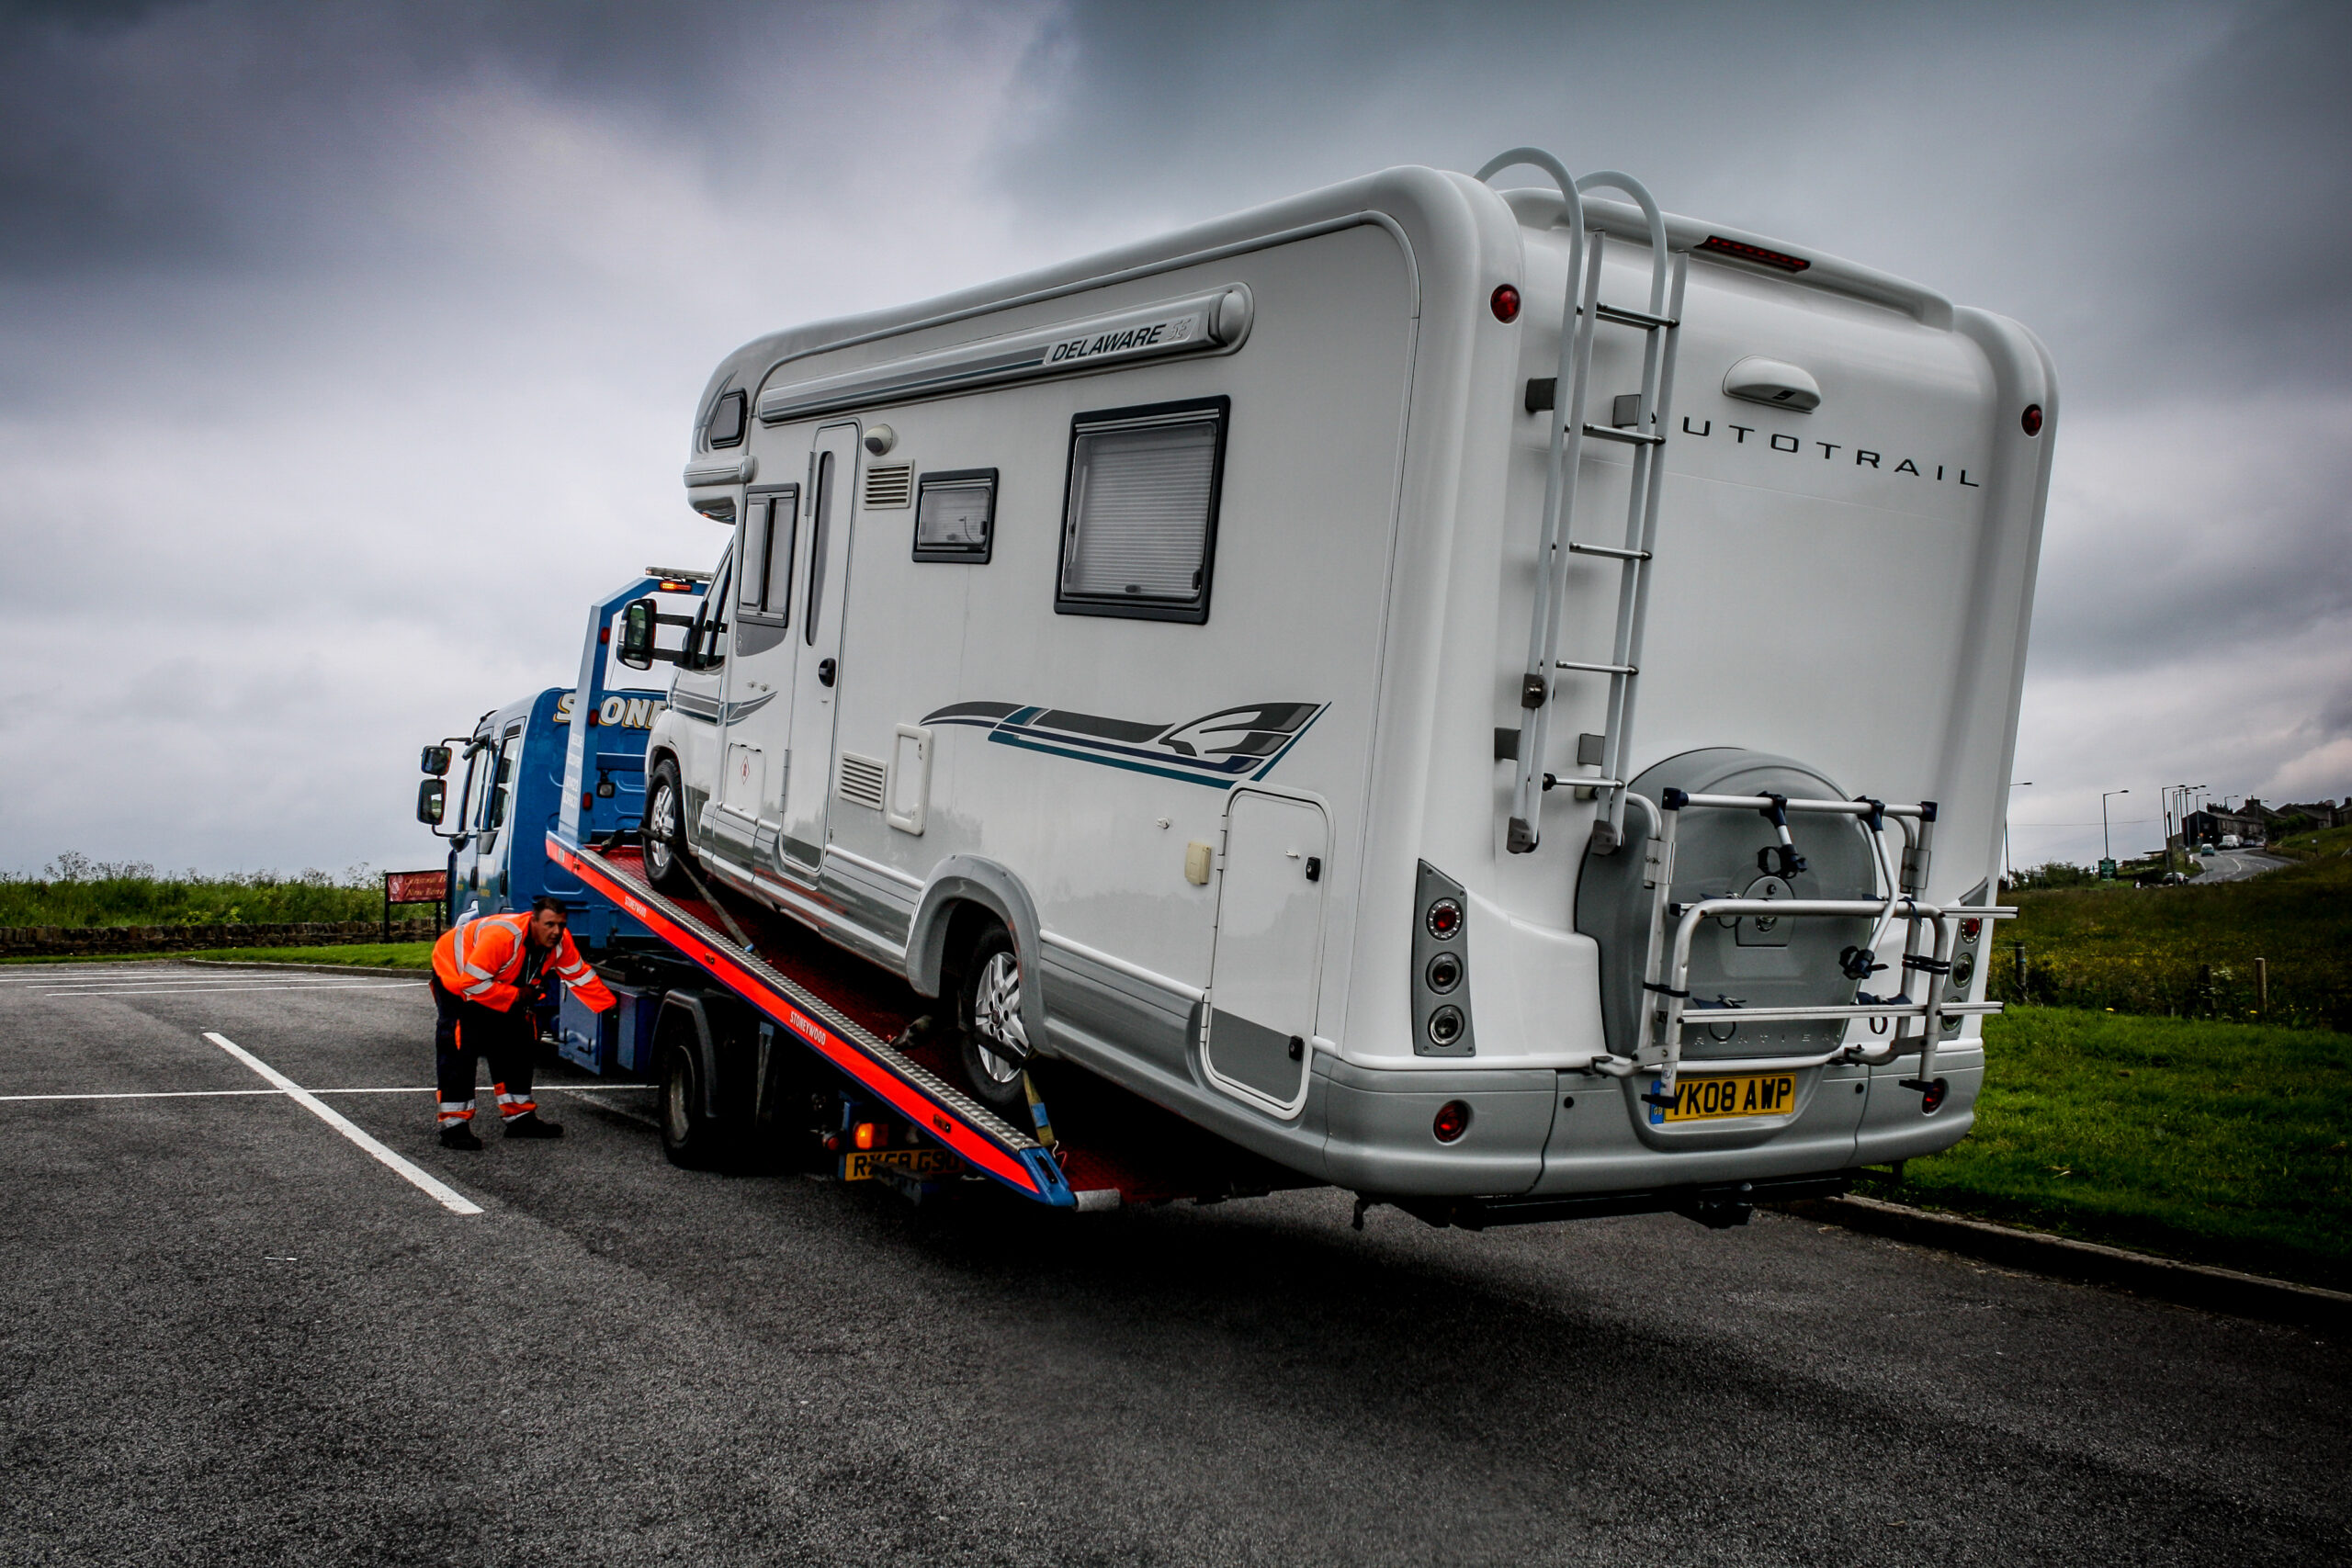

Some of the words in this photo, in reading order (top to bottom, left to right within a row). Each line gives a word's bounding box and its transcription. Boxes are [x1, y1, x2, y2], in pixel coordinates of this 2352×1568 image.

[1051, 323, 1167, 363] DELAWARE
[1651, 410, 1979, 488] UTOTRAIL
[552, 693, 668, 728] SONE
[790, 1010, 826, 1046] STONEYWOOD
[1674, 1080, 1736, 1116] YK08
[1743, 1077, 1792, 1111] AWP
